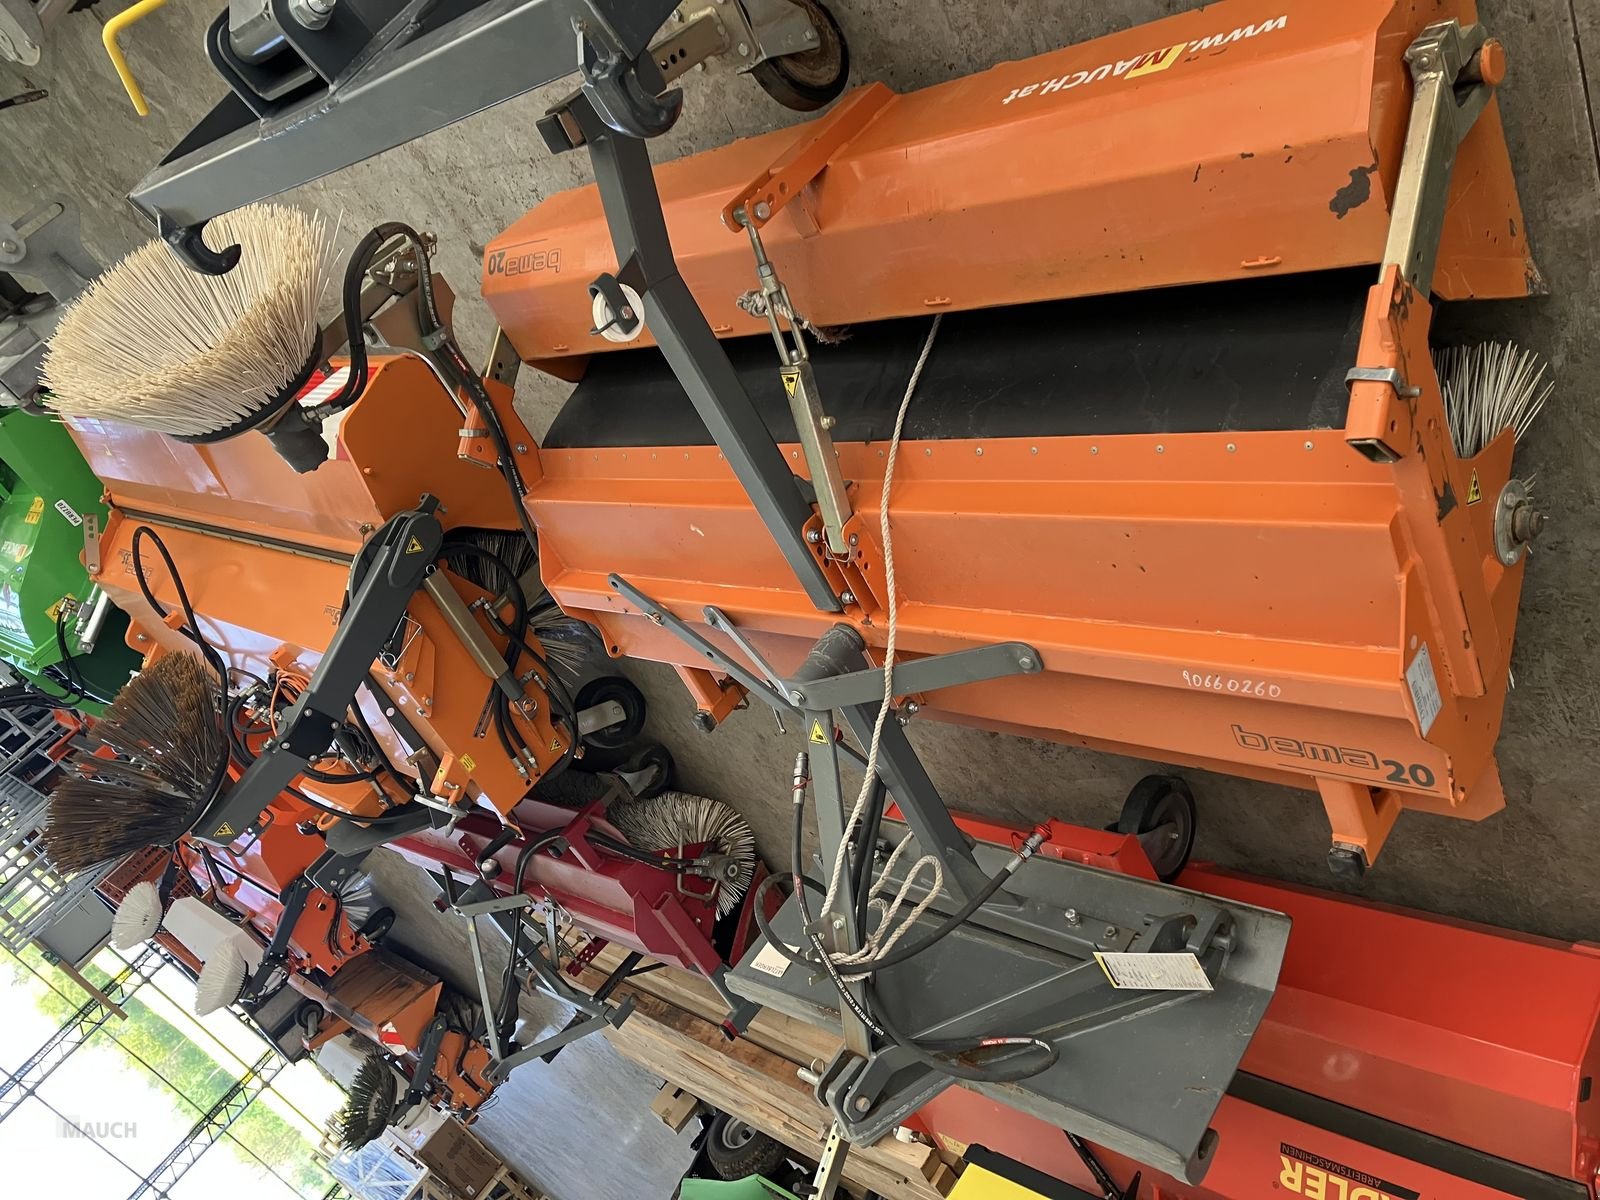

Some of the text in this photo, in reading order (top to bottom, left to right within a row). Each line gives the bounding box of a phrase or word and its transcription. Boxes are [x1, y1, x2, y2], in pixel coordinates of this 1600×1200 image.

[1002, 15, 1288, 105] www.MAUCH.at
[488, 247, 562, 276] bema 20
[57, 502, 81, 524] PERUZZO
[1182, 670, 1281, 698] 90660260
[1231, 724, 1435, 787] bema 20
[1281, 1144, 1383, 1188] ARBEITSMASCHINEN
